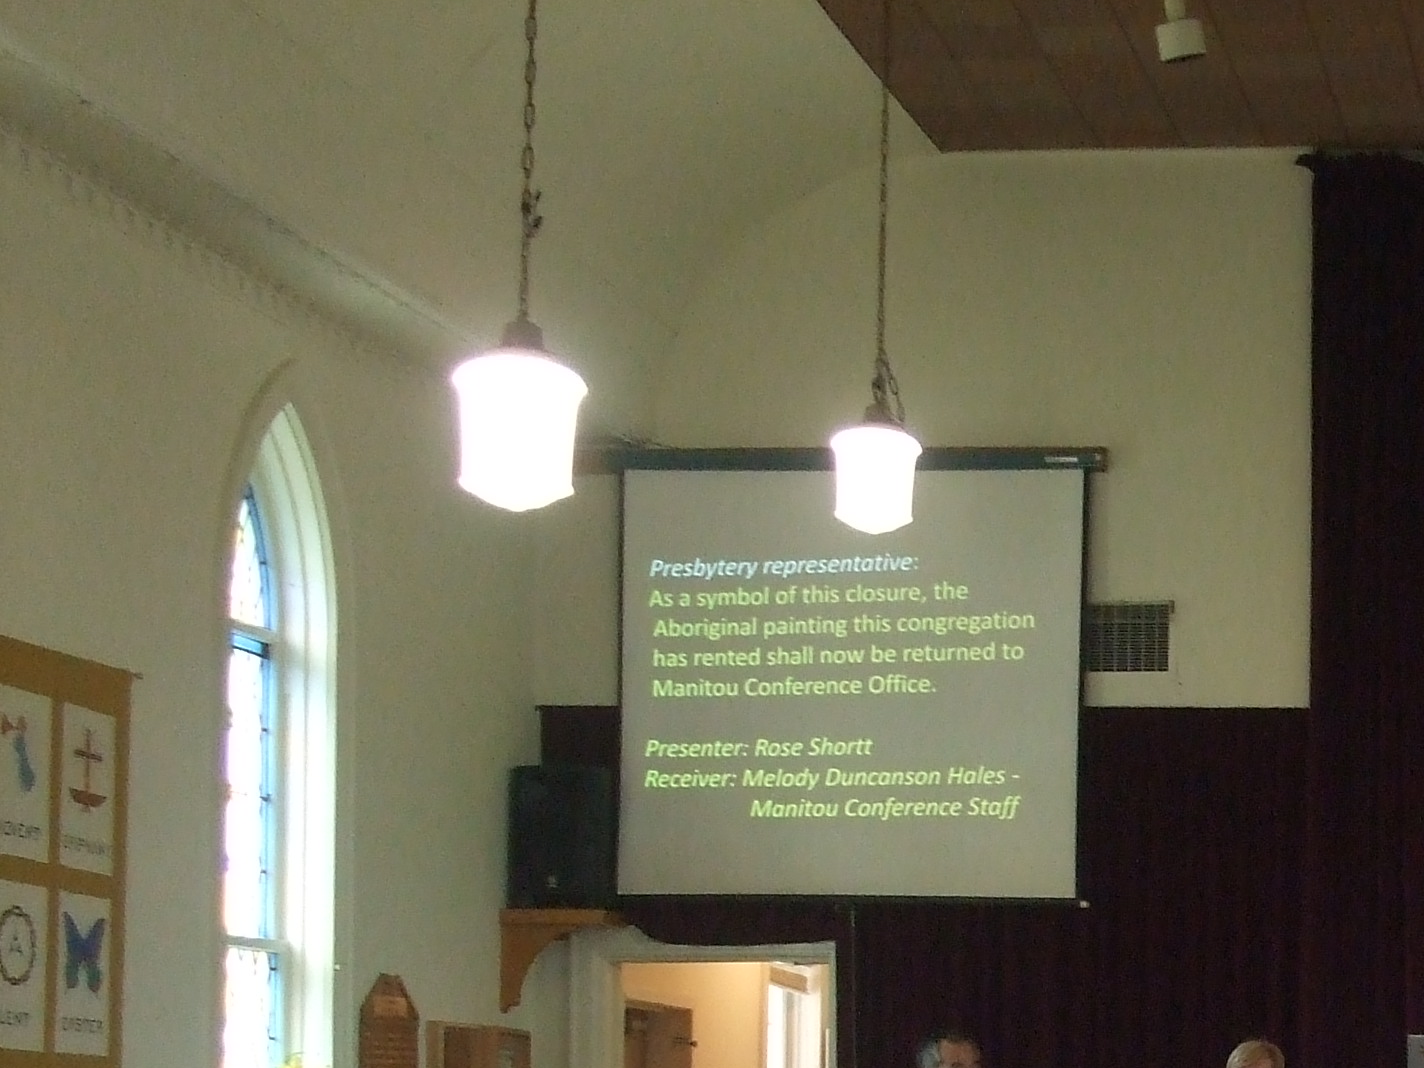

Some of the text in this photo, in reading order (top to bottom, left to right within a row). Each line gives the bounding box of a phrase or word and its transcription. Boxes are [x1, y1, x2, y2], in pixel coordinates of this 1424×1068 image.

[650, 553, 919, 580] Presbytery representative:
[650, 580, 969, 610] As a symbol of this closure, the
[653, 610, 1036, 640] Aboriginal painting this congregation
[653, 641, 1025, 668] has rented shall now be returned to
[653, 673, 937, 698] Manitou Conference Office.
[645, 736, 874, 758] Presenter: Rose Shortt
[644, 769, 737, 788] Receiver:
[742, 767, 820, 791] Melody
[825, 767, 942, 788] Duncanson
[947, 766, 1006, 786] Hales
[750, 795, 1022, 821] Manitou Conference Staff
